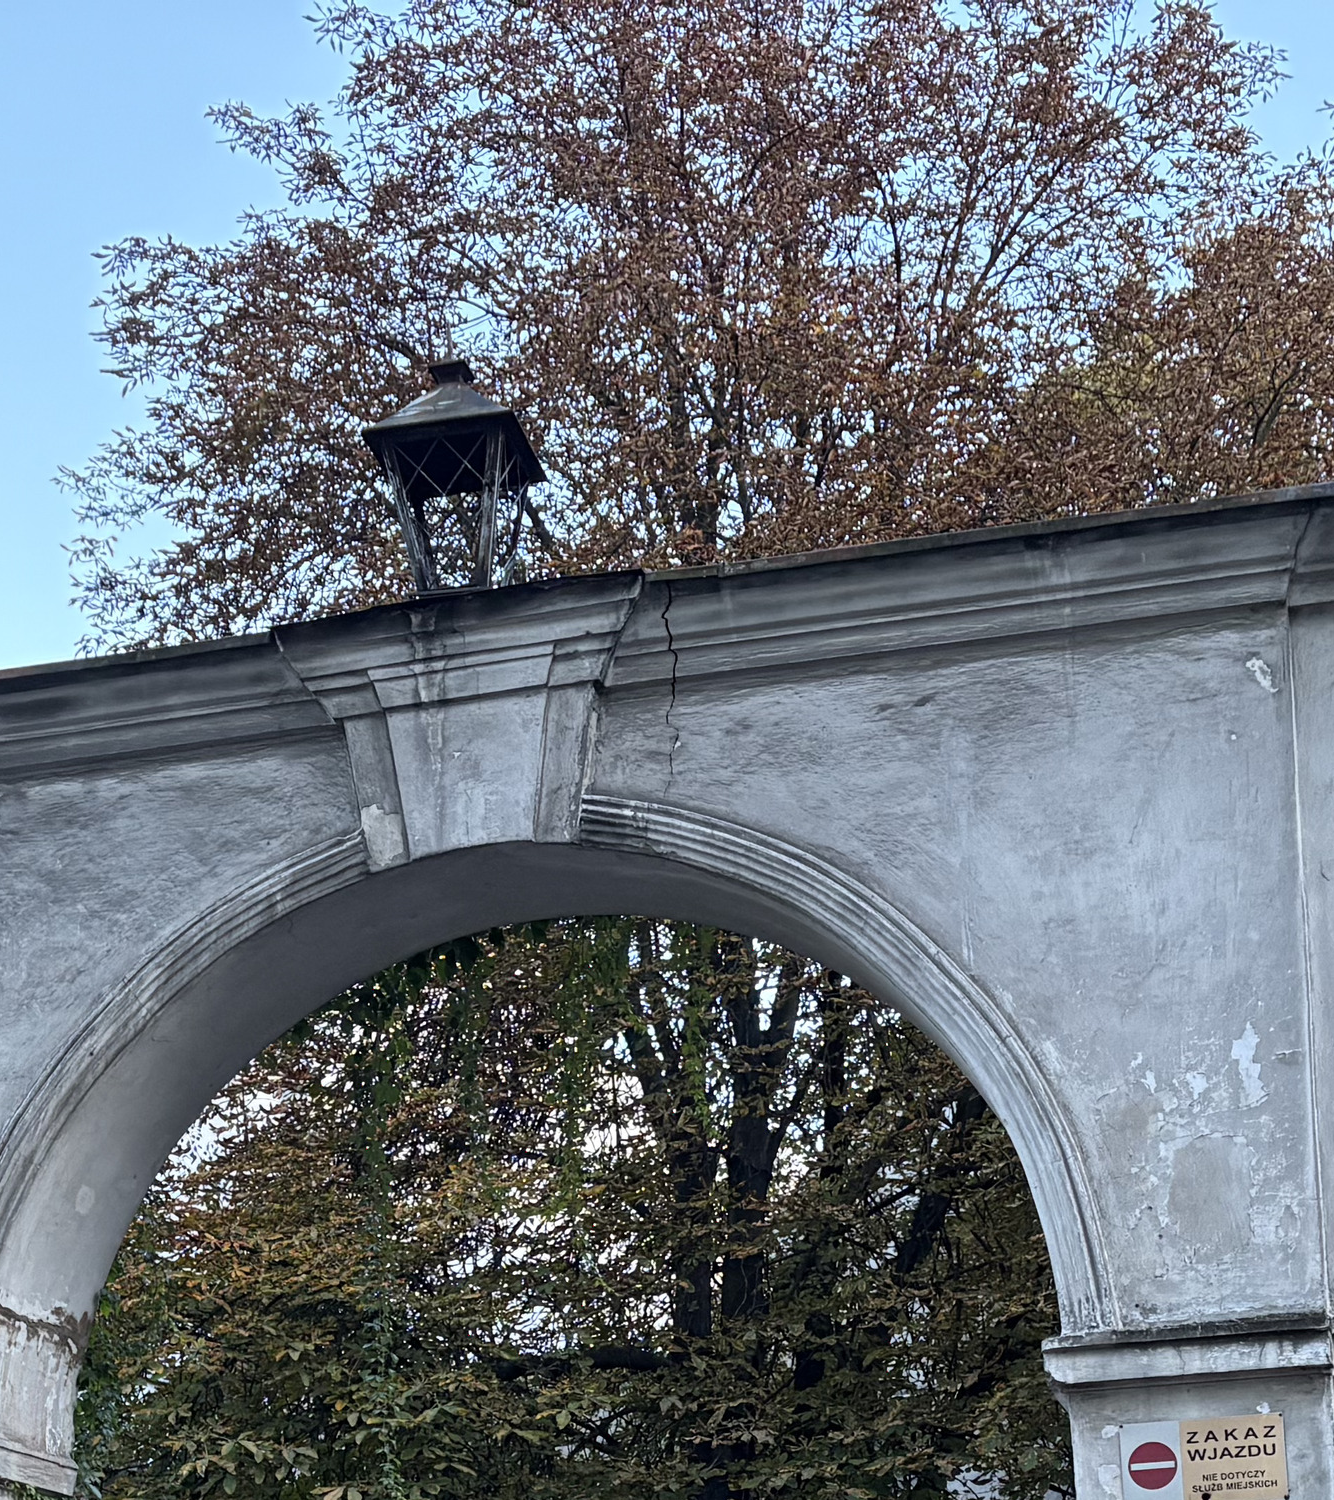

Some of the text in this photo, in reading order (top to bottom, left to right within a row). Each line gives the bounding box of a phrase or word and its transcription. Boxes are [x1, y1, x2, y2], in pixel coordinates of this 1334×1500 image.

[1186, 1425, 1277, 1444] ZAKAZ
[1186, 1443, 1277, 1462] WJAZDU
[1202, 1470, 1267, 1482] NIE DOTYCZY
[1192, 1479, 1278, 1493] SŁUŻB MIEJSKICH
